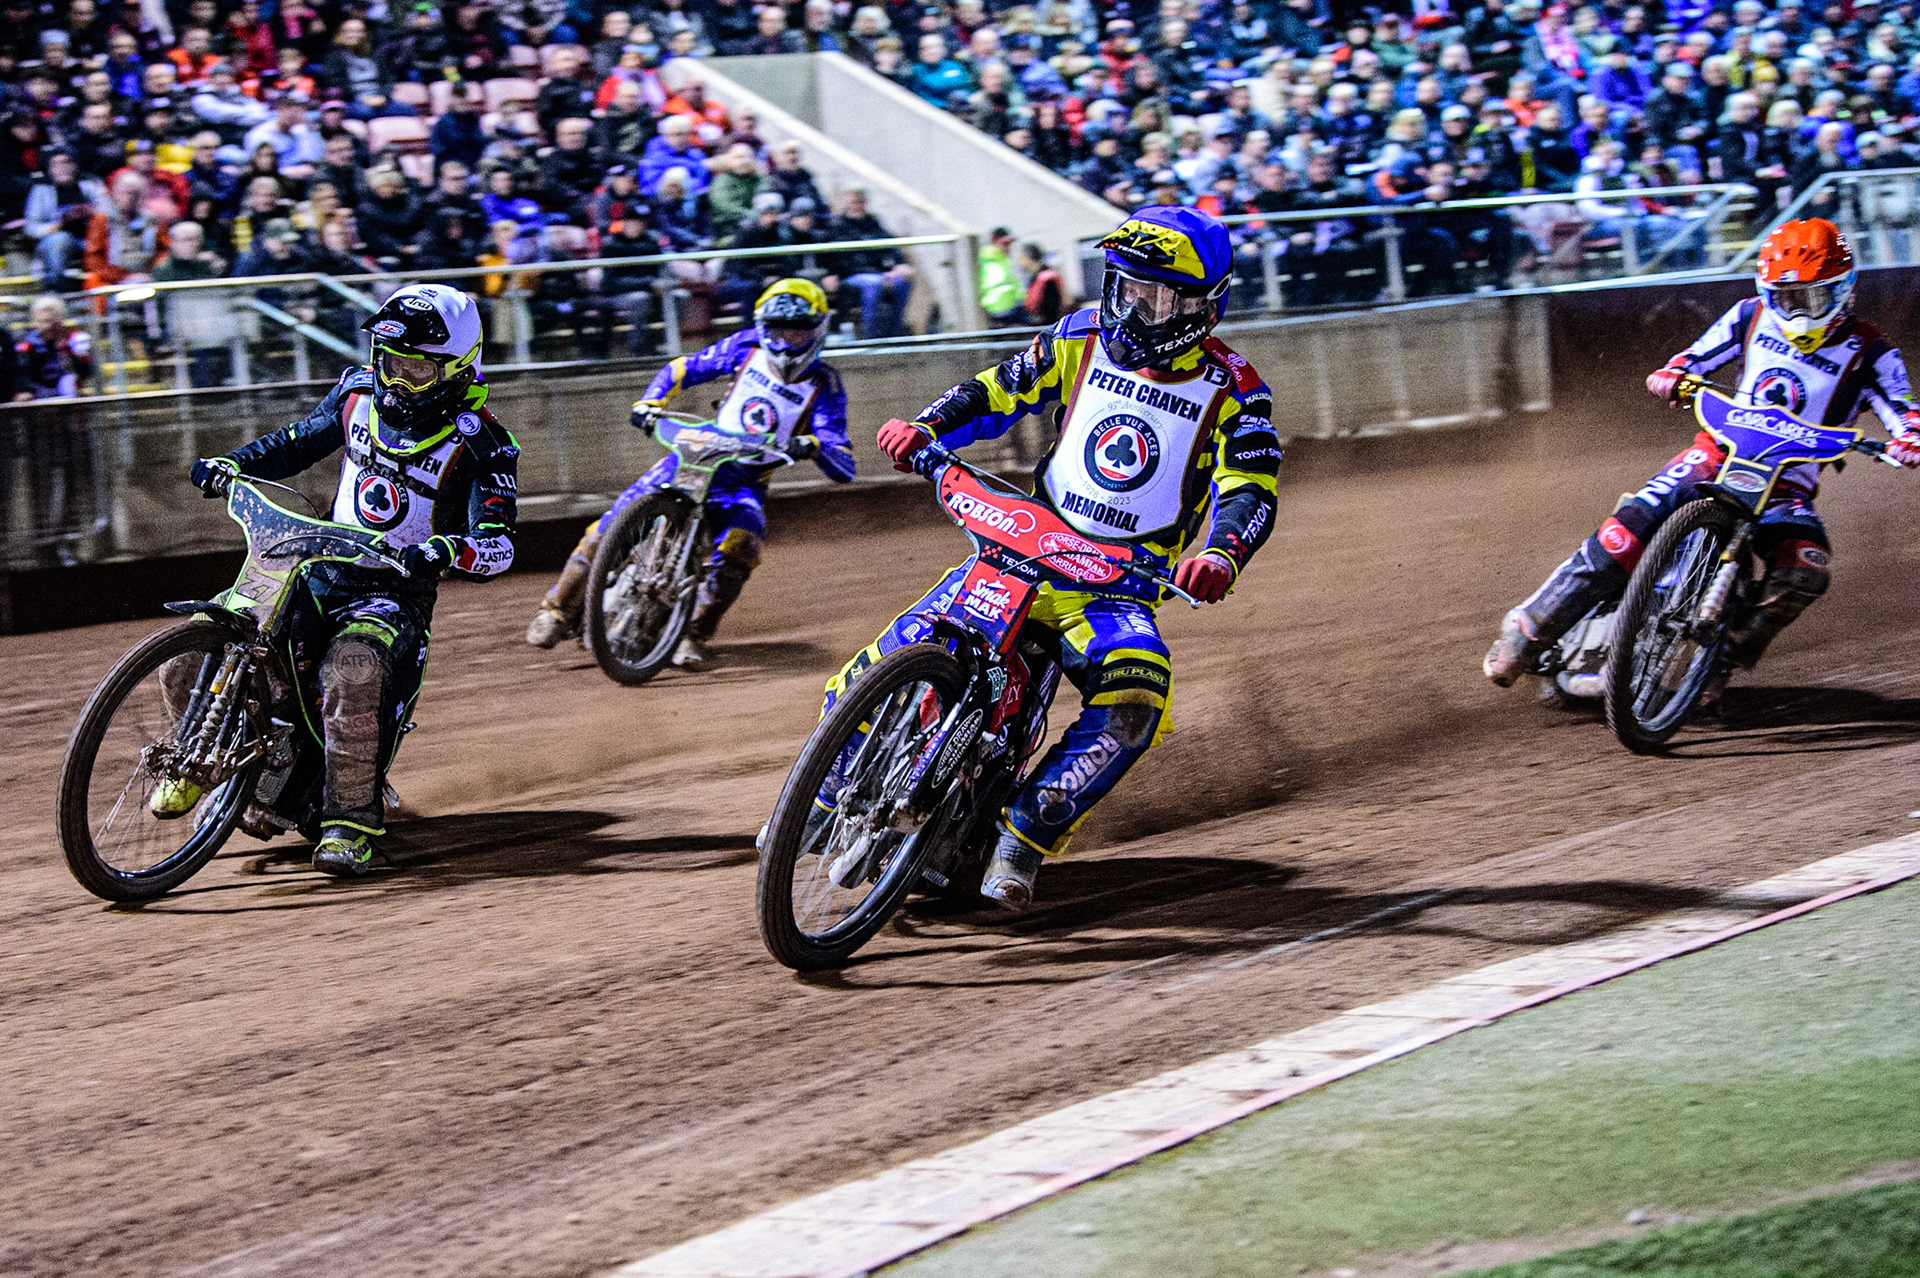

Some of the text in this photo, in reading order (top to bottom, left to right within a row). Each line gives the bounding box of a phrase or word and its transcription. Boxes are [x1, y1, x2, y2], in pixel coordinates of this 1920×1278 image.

[408, 298, 431, 310] Arai
[1155, 325, 1206, 353] TEXOM
[1088, 368, 1136, 399] PETER
[1203, 365, 1230, 387] 13
[1136, 384, 1203, 422] CRAVEN
[1093, 416, 1159, 457] BELLE VUE ACES
[1235, 448, 1267, 460] TONY
[357, 467, 376, 484] BELLE
[395, 482, 408, 503] ACES
[1082, 480, 1100, 498] 1928
[1107, 497, 1131, 505] 2023
[947, 491, 1020, 538] ROBSON
[1061, 491, 1140, 533] MEMORIAL
[1045, 551, 1096, 579] ARRIAGES
[964, 595, 1004, 619] MAK
[971, 578, 1011, 609] Smak
[1131, 667, 1164, 683] PLAST
